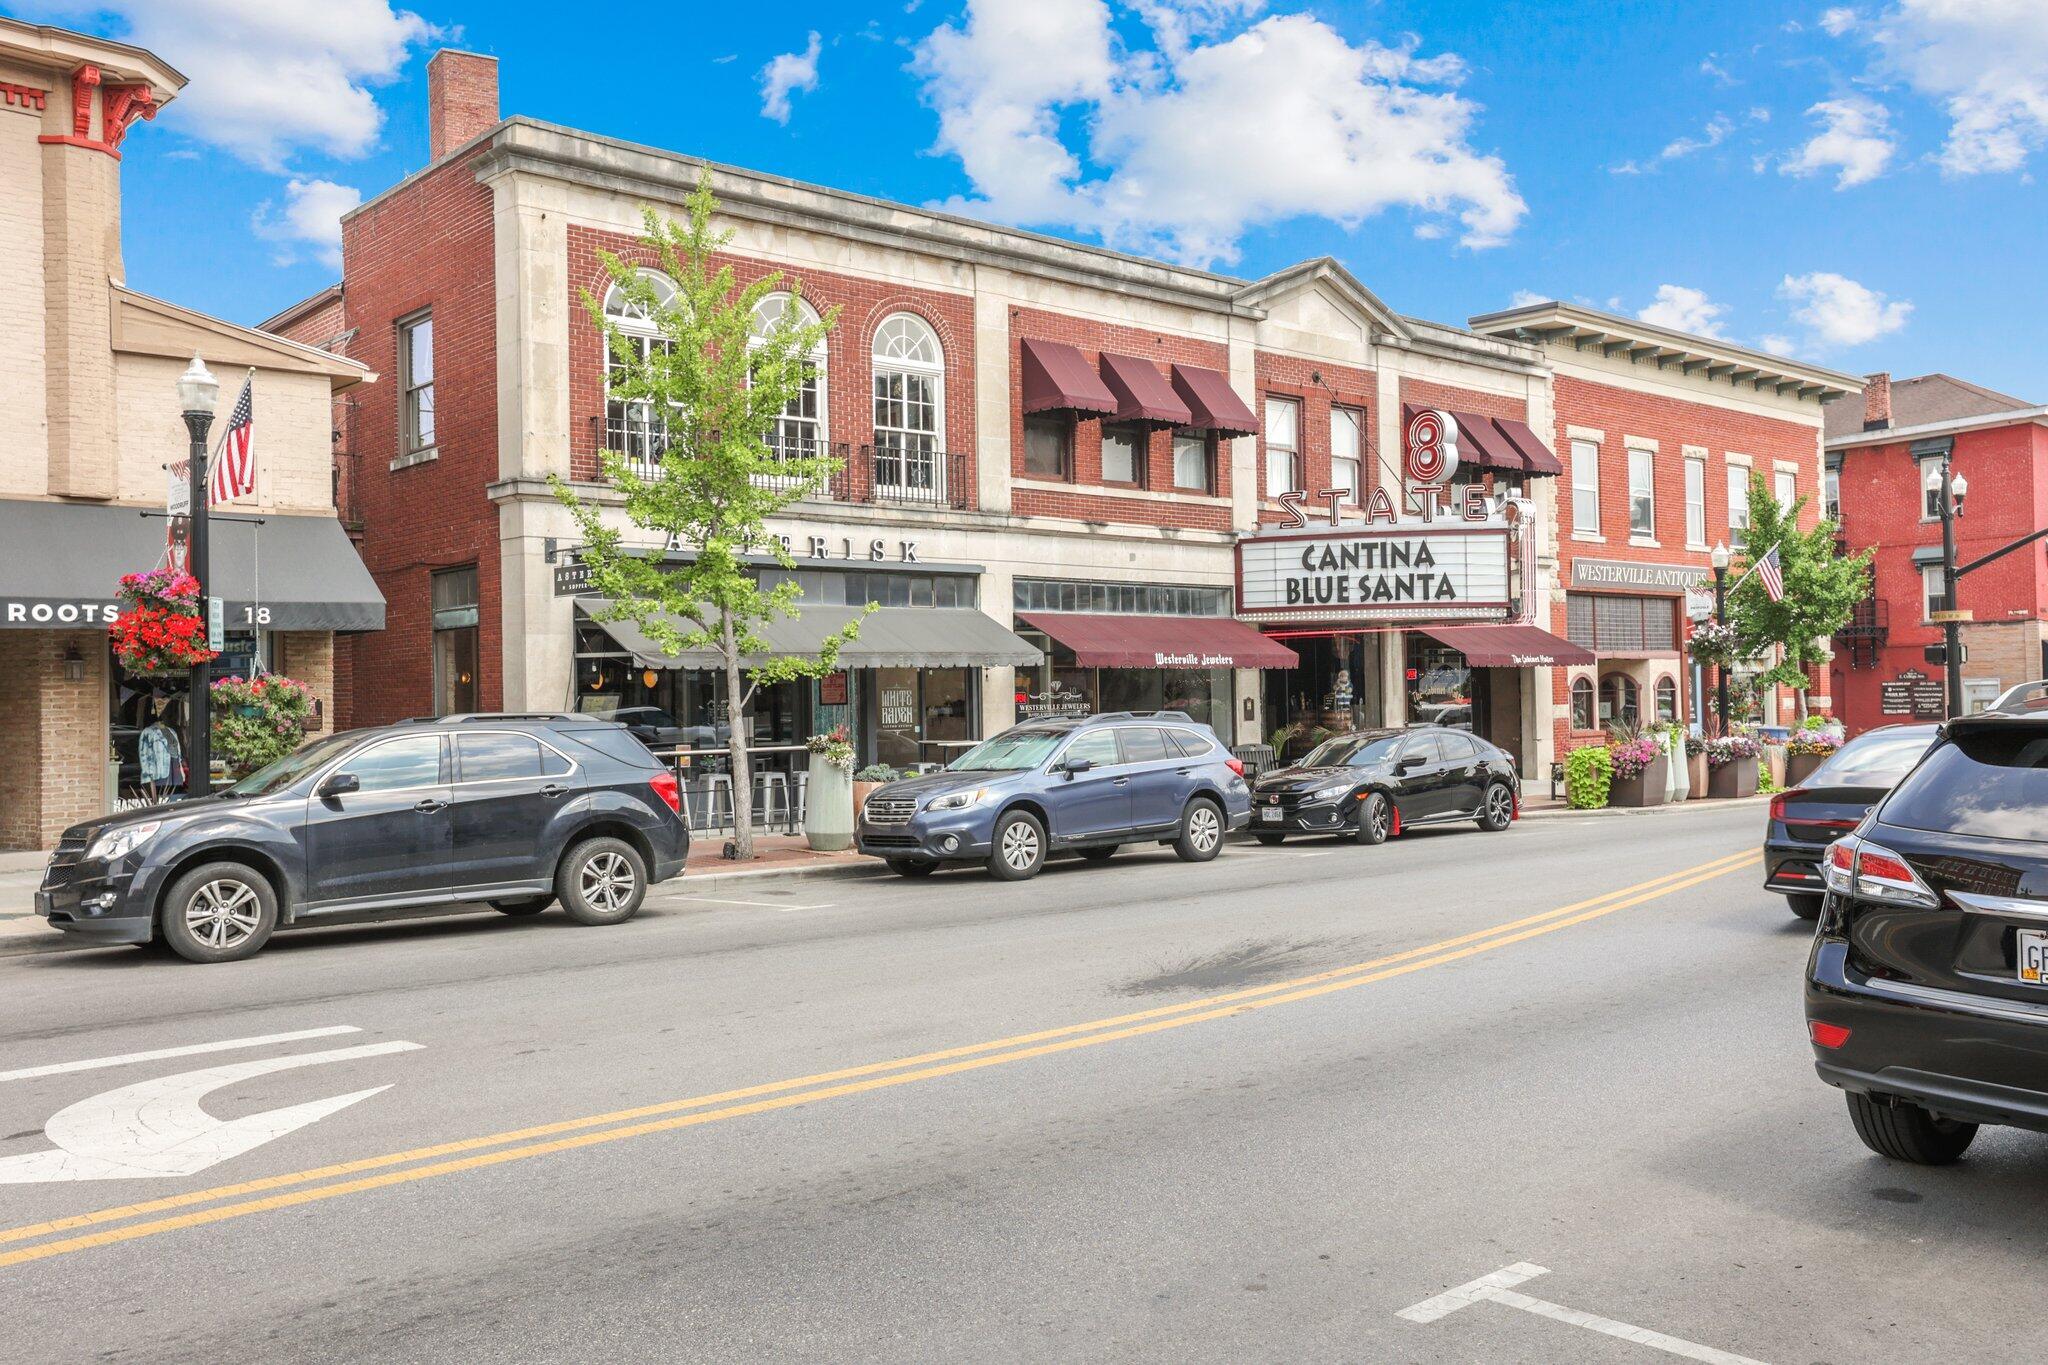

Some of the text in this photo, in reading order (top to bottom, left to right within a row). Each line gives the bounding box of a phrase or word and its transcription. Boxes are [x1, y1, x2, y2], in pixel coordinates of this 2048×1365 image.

[1407, 409, 1457, 482] 8
[1278, 484, 1488, 529] STATE
[665, 532, 922, 564] ATERISK
[1301, 540, 1436, 572] CANTINA
[557, 569, 593, 582] ASTER
[1578, 564, 1654, 585] WESTERVILLE
[1286, 572, 1457, 605] BLUE SANTA
[7, 603, 120, 623] ROOTS
[244, 606, 271, 625] 18
[1155, 652, 1234, 666] Westerville Jewelers
[881, 689, 913, 708] WHITE
[1019, 702, 1092, 712] WESTERVILLE JEWELERS
